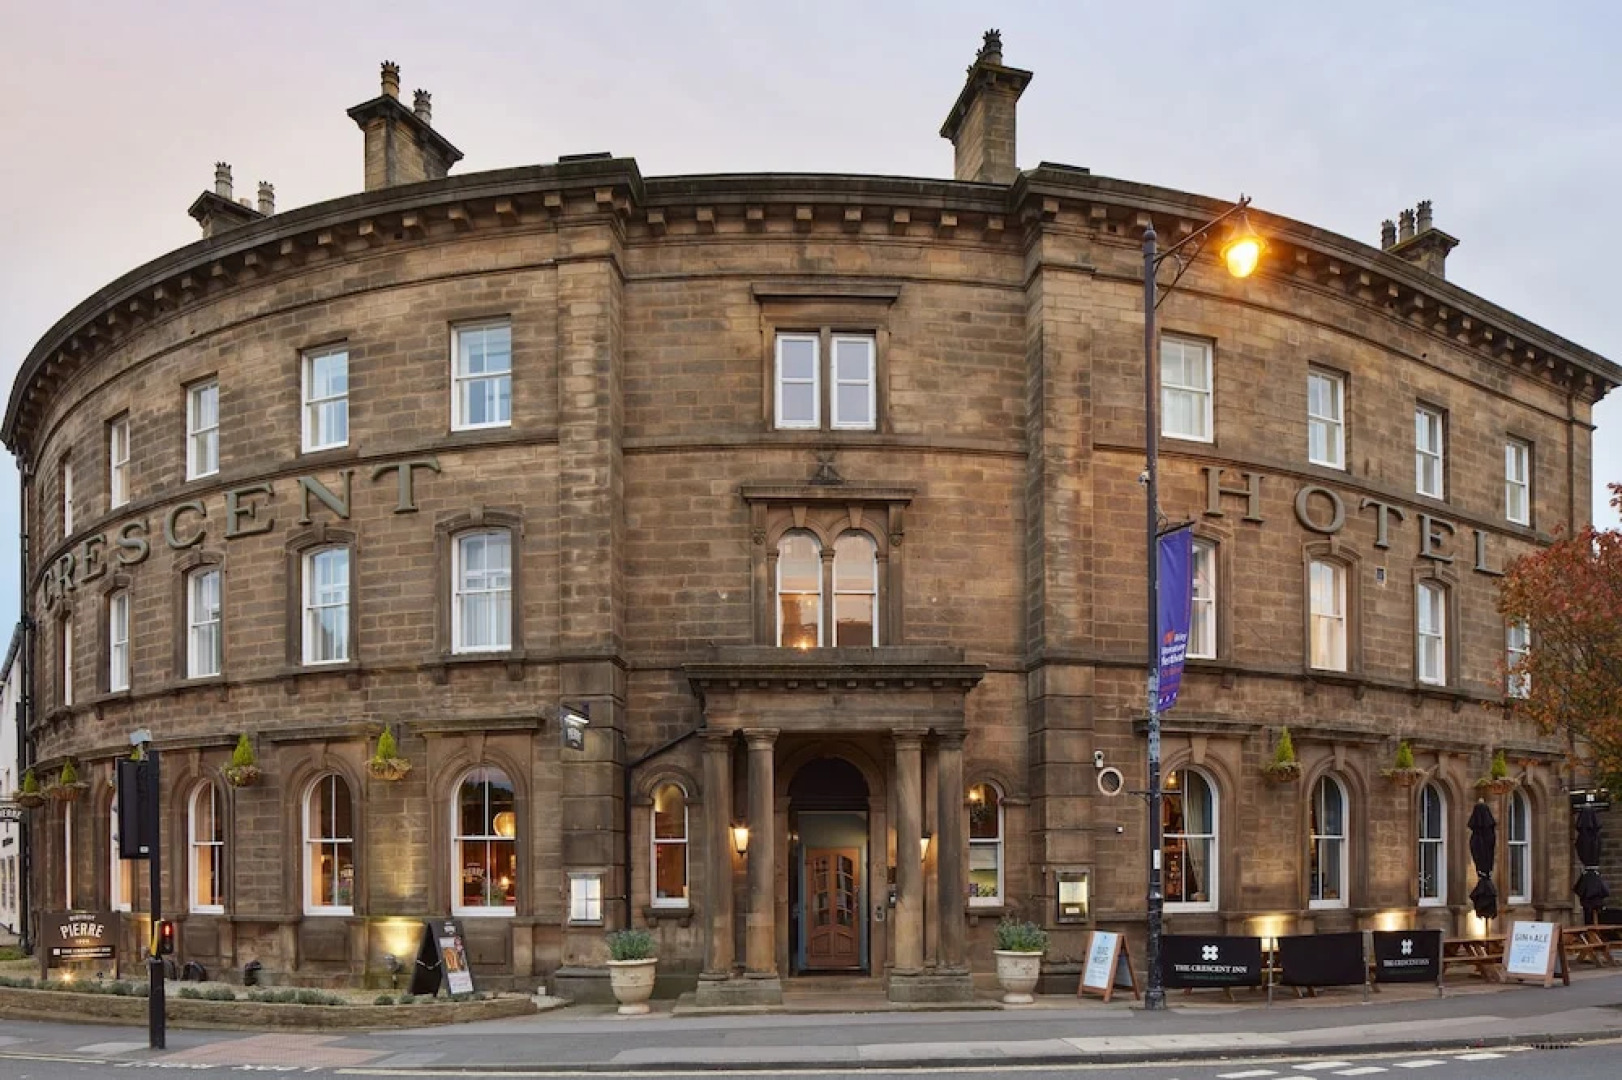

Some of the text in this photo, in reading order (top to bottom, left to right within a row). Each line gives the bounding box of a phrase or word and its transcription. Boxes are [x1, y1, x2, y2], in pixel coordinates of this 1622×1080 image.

[40, 458, 1505, 611] CRESCENT HOTEL
[60, 922, 105, 939] PIERRE
[1174, 964, 1248, 974] THE CRESCENT INN
